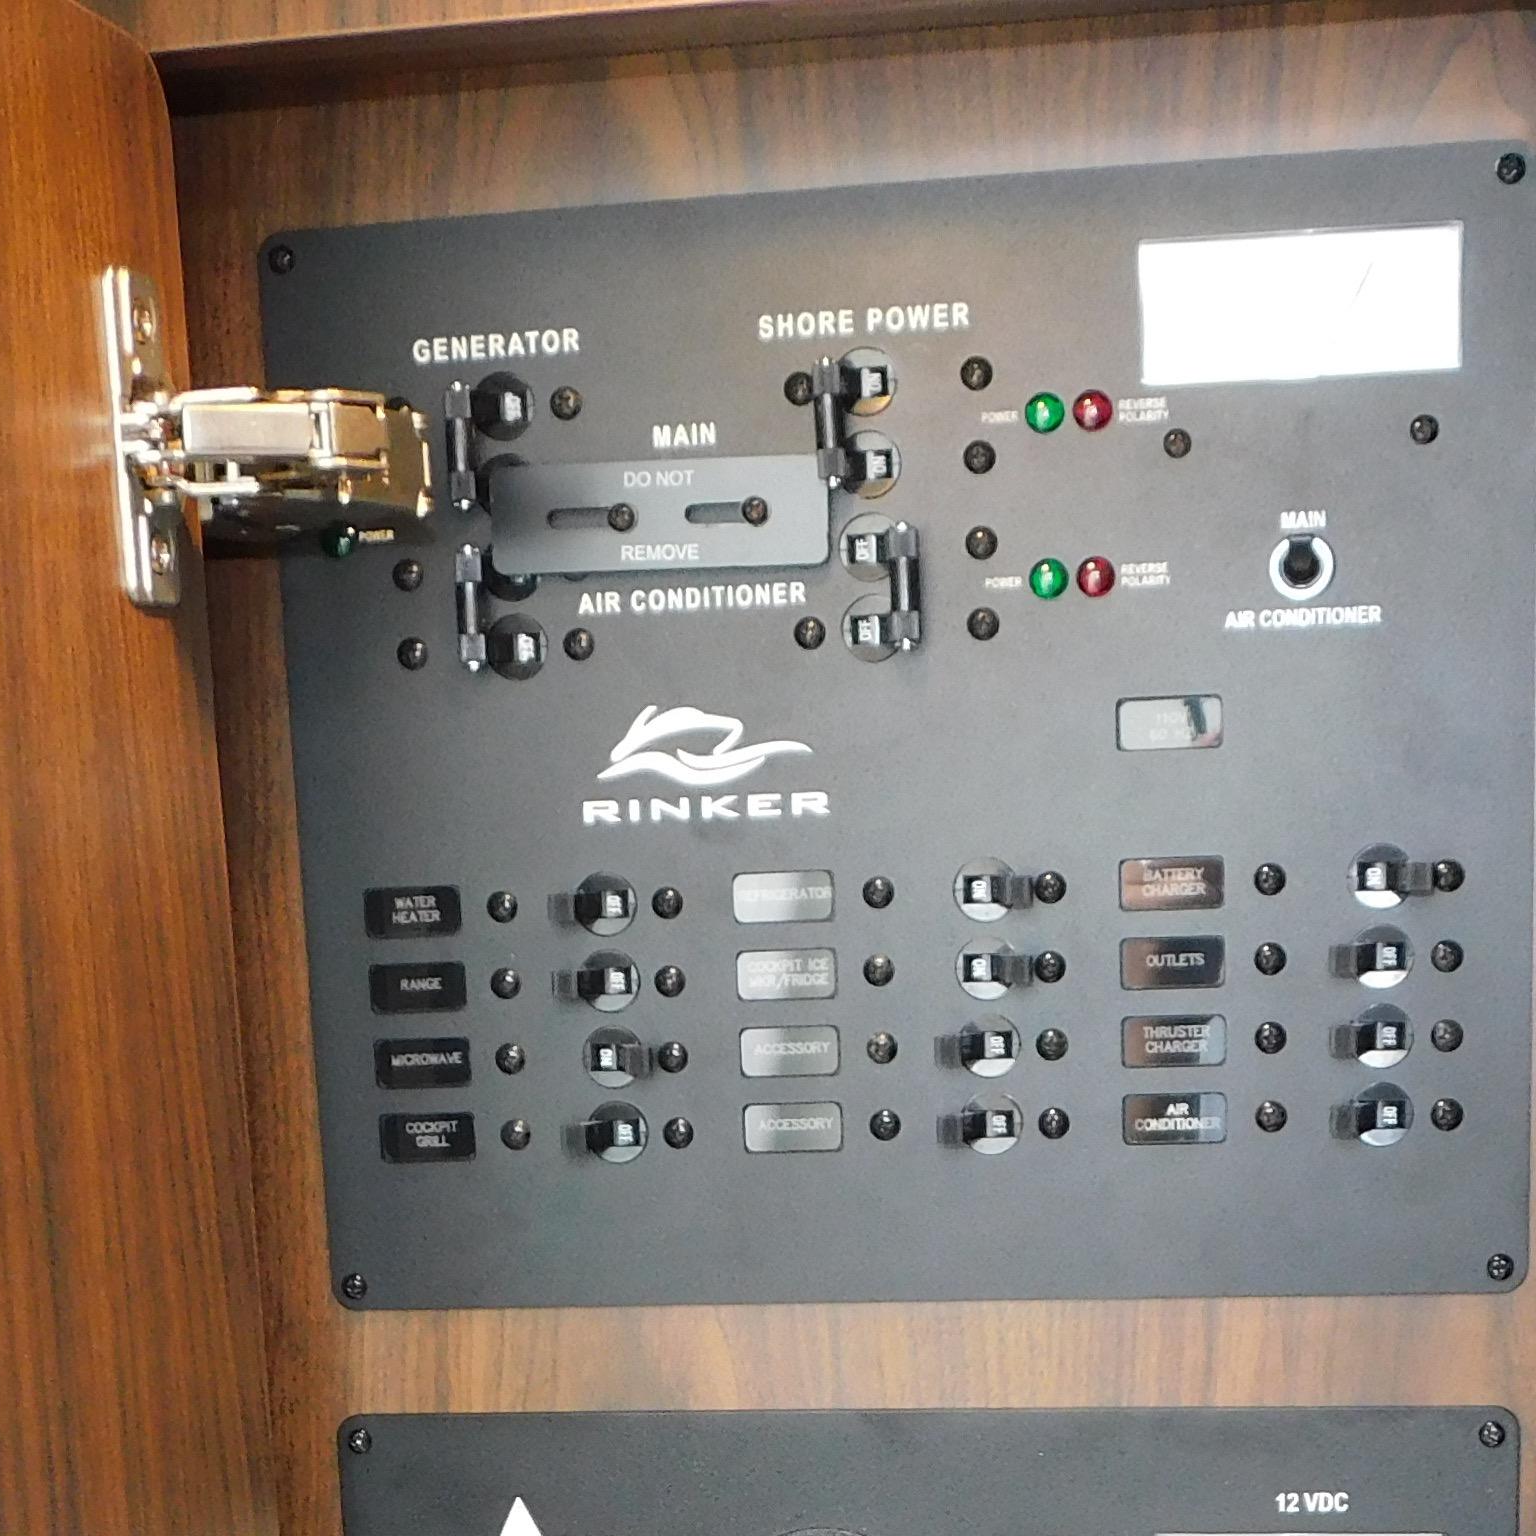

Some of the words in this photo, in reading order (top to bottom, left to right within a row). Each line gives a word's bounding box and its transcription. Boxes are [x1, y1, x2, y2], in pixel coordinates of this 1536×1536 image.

[758, 309, 854, 340] SHORE
[867, 302, 970, 331] POWER
[413, 328, 580, 364] GENERATOR
[652, 422, 717, 448] MAIN
[624, 472, 651, 488] DO
[655, 470, 694, 486] NOT
[1280, 510, 1327, 529] MAIN
[621, 544, 699, 561] REMOVE
[578, 590, 624, 615] AIR
[630, 581, 807, 612] CONDITIONER
[1224, 608, 1256, 629] AIR
[1260, 604, 1381, 628] CONDITIONER
[582, 790, 832, 825] RINKER
[1142, 867, 1204, 883] BATTERY
[1142, 880, 1207, 897] CHARGER
[394, 895, 436, 910] WATER
[392, 909, 441, 925] HEATER
[746, 958, 803, 974] COCKPIT
[807, 957, 829, 972] ICE
[1146, 953, 1205, 967] OUTLETS
[400, 976, 443, 993] RANGE
[1142, 1024, 1211, 1040] THRUSTER
[753, 1040, 831, 1057] ACCESSORY
[1145, 1038, 1206, 1053] CHARGER
[391, 1051, 463, 1068] MICROWAVE
[1165, 1103, 1189, 1117] AIR
[405, 1120, 458, 1136] COCKPIT
[759, 1115, 834, 1133] ACCESSORY
[1135, 1115, 1221, 1131] CONDITIONER
[1276, 1493, 1299, 1513] 12
[1304, 1492, 1349, 1513] VDC
